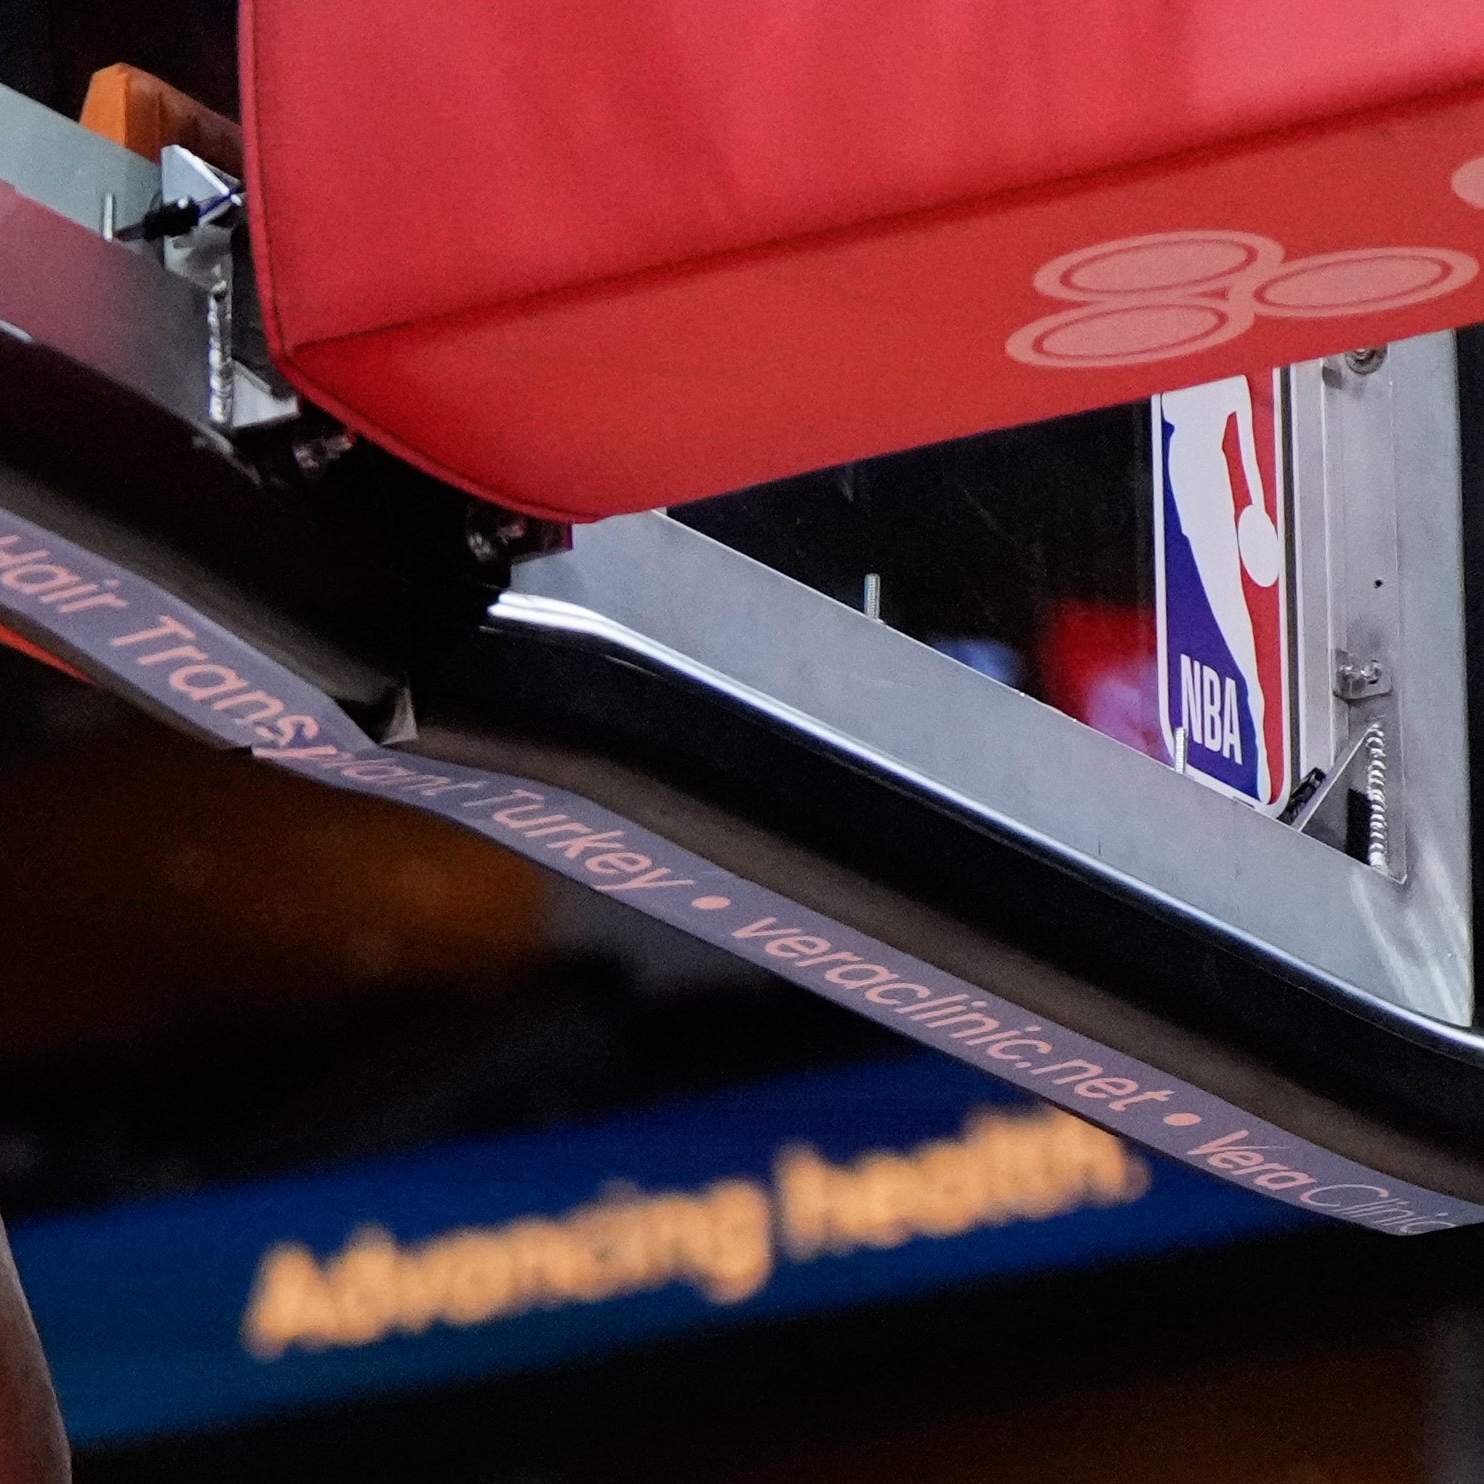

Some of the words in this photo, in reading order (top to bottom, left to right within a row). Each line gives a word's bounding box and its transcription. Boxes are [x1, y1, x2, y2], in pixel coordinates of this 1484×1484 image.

[1180, 653, 1243, 766] NBA
[463, 788, 695, 892] Turkey
[732, 916, 1173, 1112] veraclinic.net
[1187, 1131, 1317, 1191] Vera
